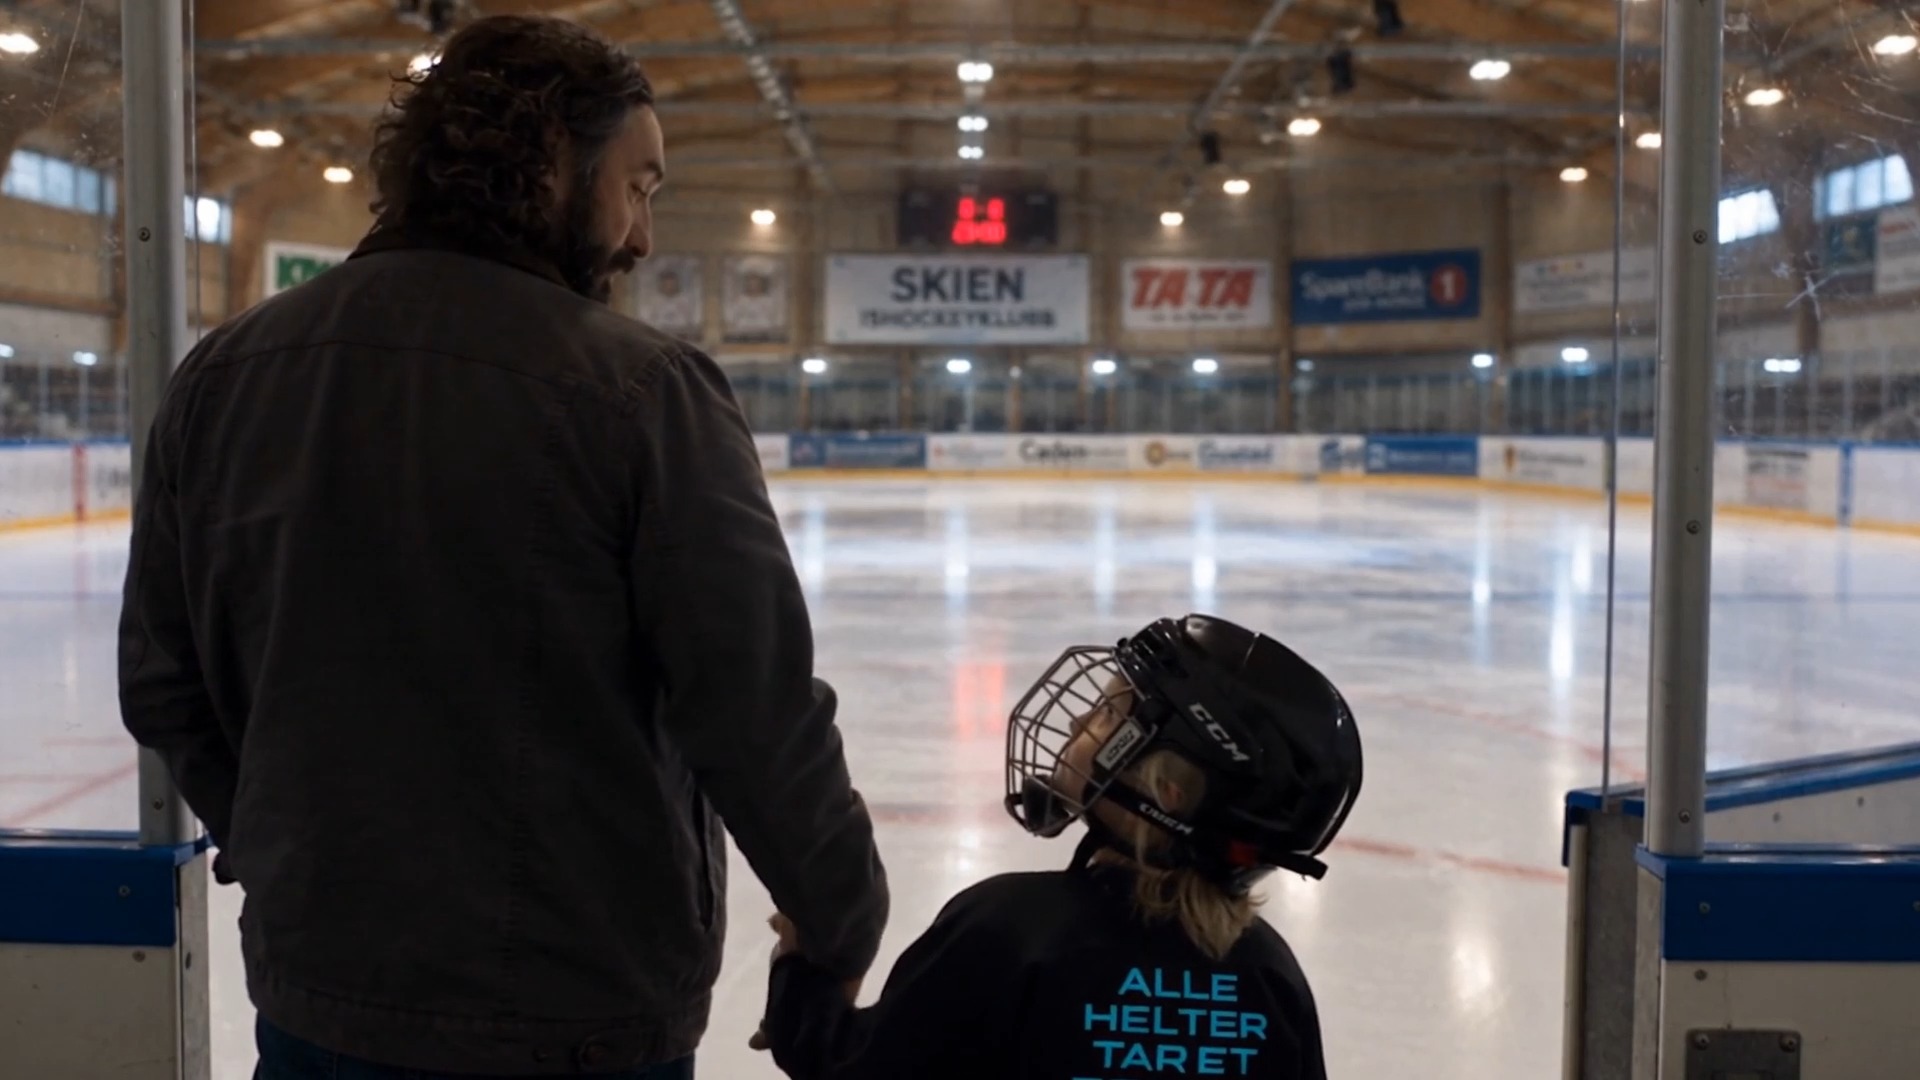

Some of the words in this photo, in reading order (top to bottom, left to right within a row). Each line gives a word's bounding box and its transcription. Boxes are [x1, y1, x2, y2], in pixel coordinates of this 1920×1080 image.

[891, 267, 1025, 303] SKIEN
[1440, 270, 1457, 301] 1
[1188, 702, 1251, 761] CCM
[1118, 967, 1239, 1003] ALLE
[1084, 1003, 1268, 1041] HELTER
